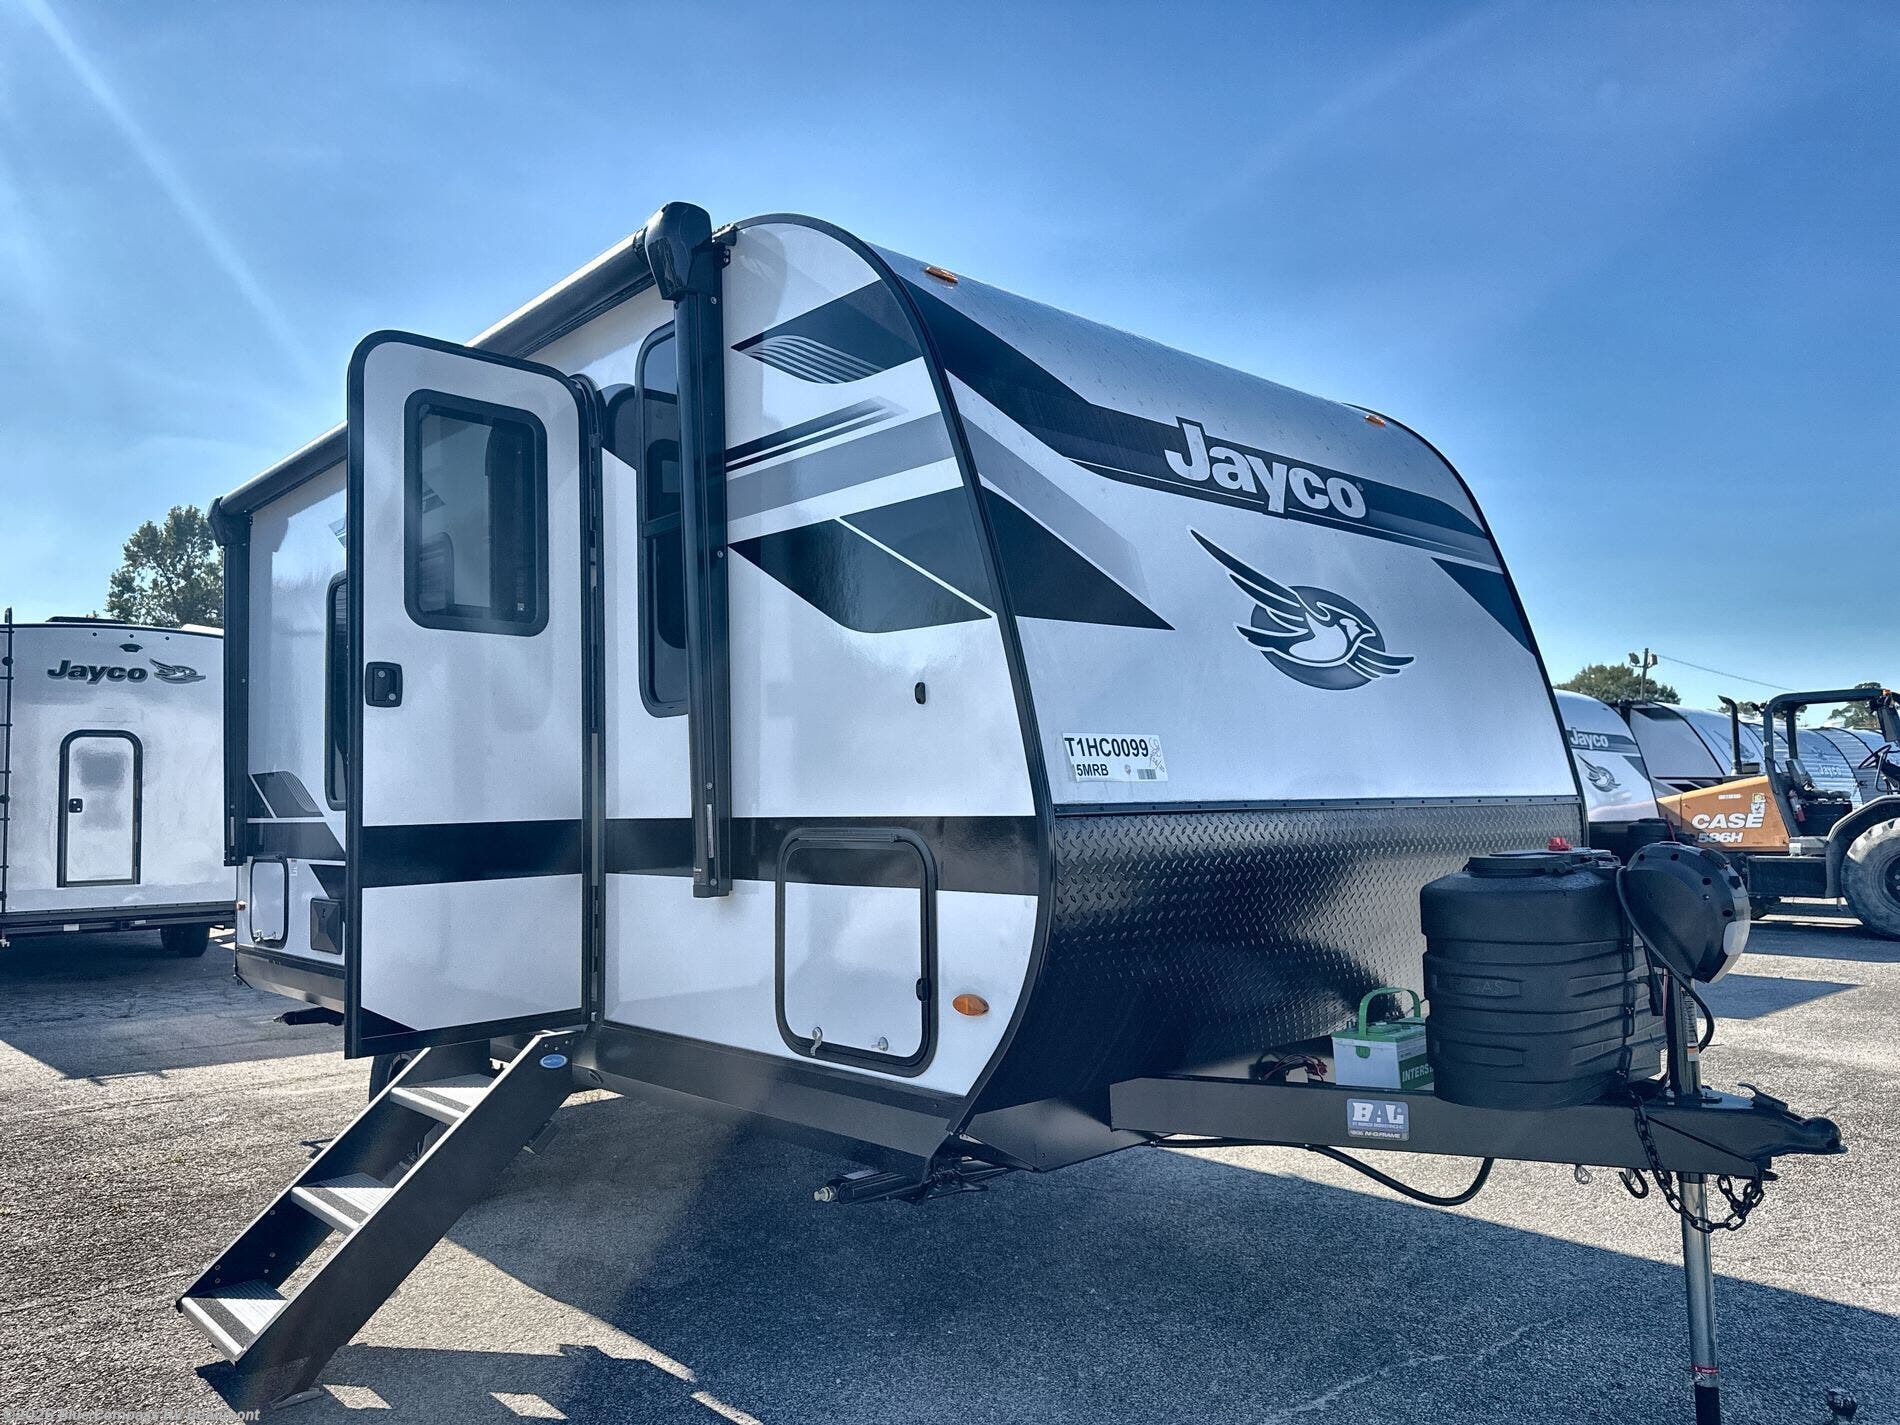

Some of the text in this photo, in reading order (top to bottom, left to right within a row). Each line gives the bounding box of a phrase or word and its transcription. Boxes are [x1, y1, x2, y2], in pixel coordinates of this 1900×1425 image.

[1164, 422, 1366, 519] Jayco
[46, 659, 149, 685] Jayco
[1063, 737, 1149, 757] T1HC0099
[1570, 727, 1609, 751] Jayco
[1691, 812, 1765, 830] CASE
